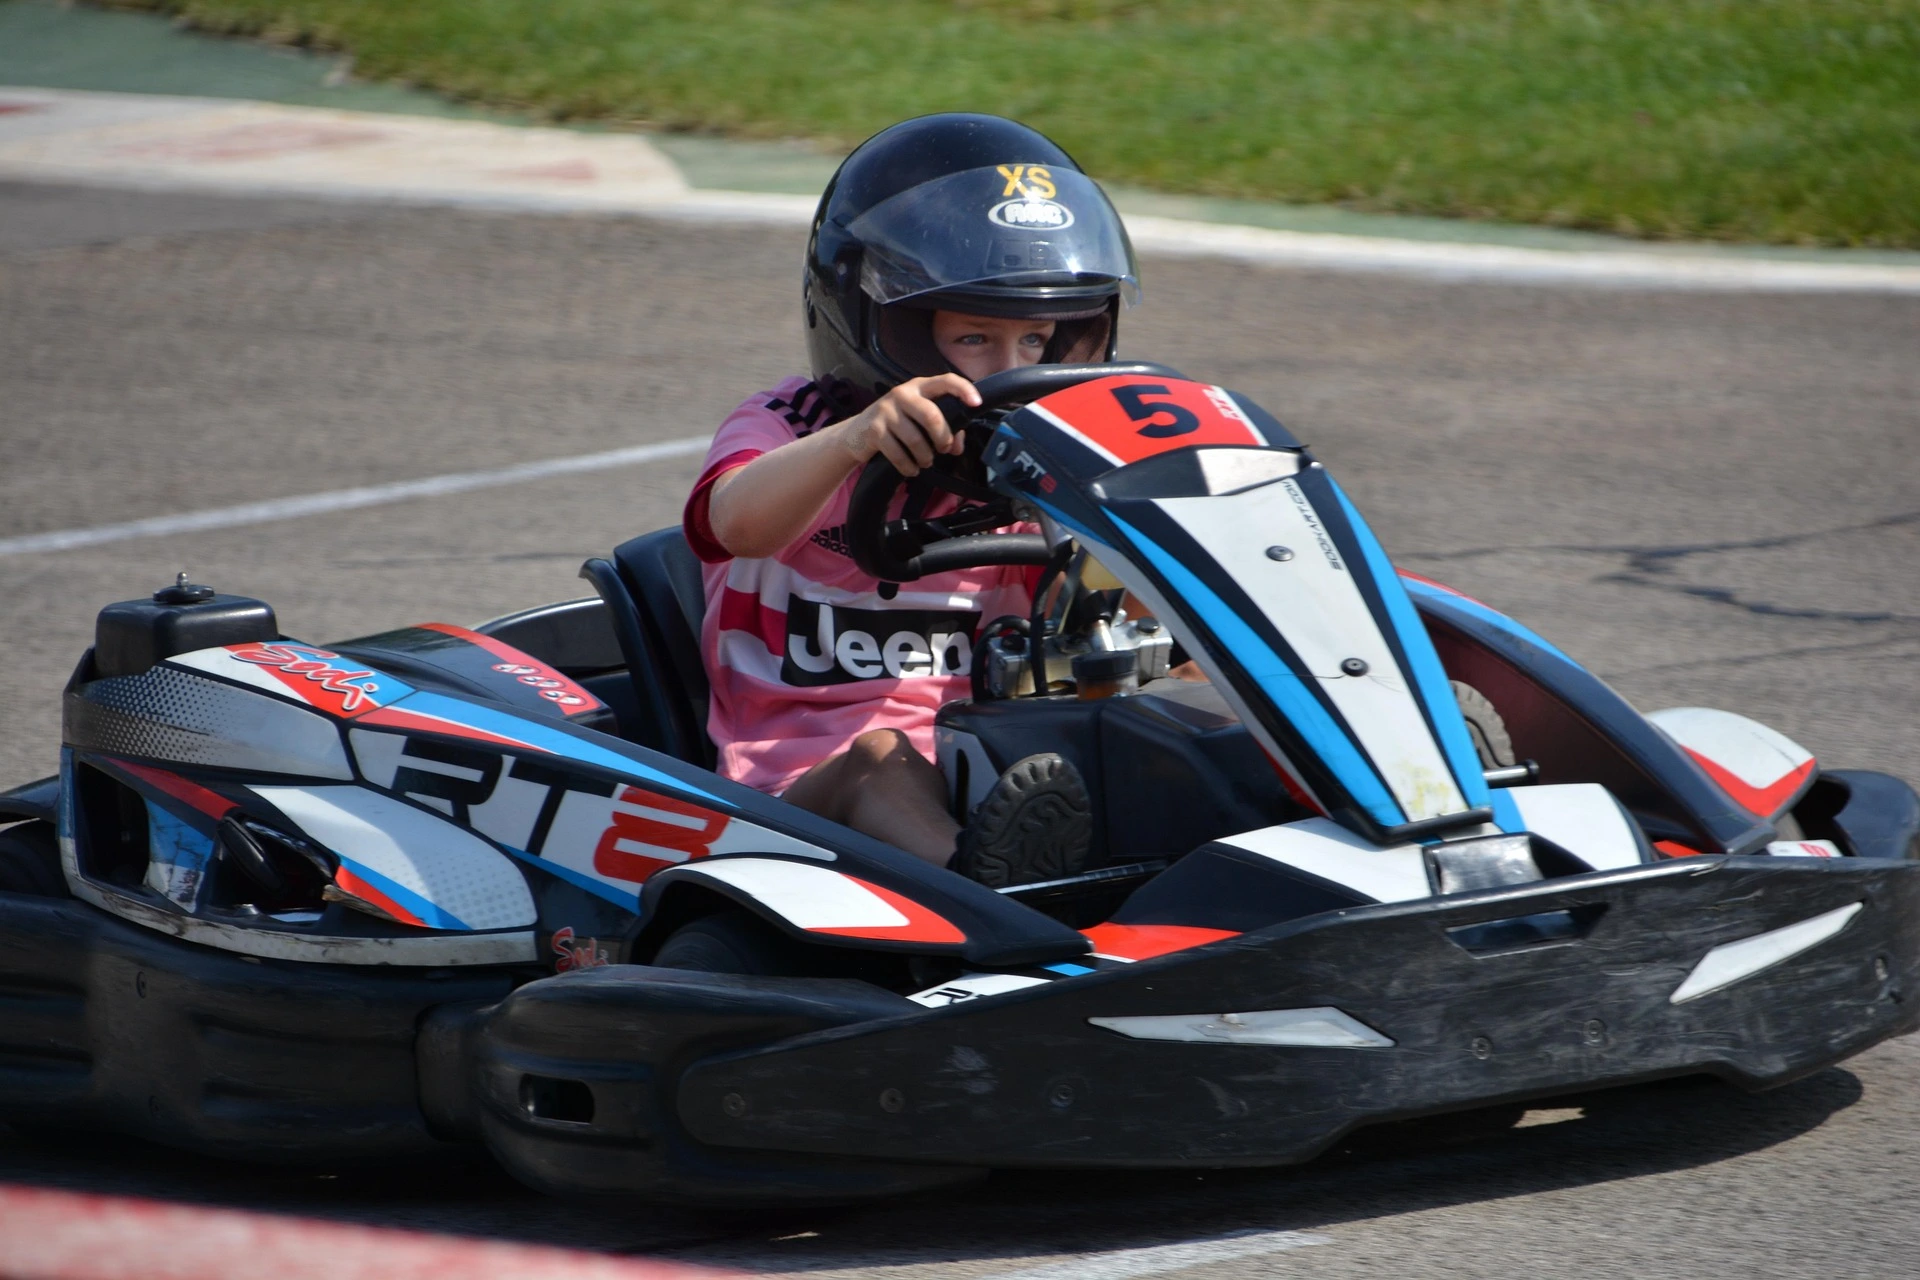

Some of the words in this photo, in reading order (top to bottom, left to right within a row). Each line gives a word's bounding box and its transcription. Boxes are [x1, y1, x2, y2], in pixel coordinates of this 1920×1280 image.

[996, 165, 1057, 199] XS
[1110, 383, 1200, 438] 5
[788, 603, 973, 678] Jeep
[231, 644, 379, 711] Sodi
